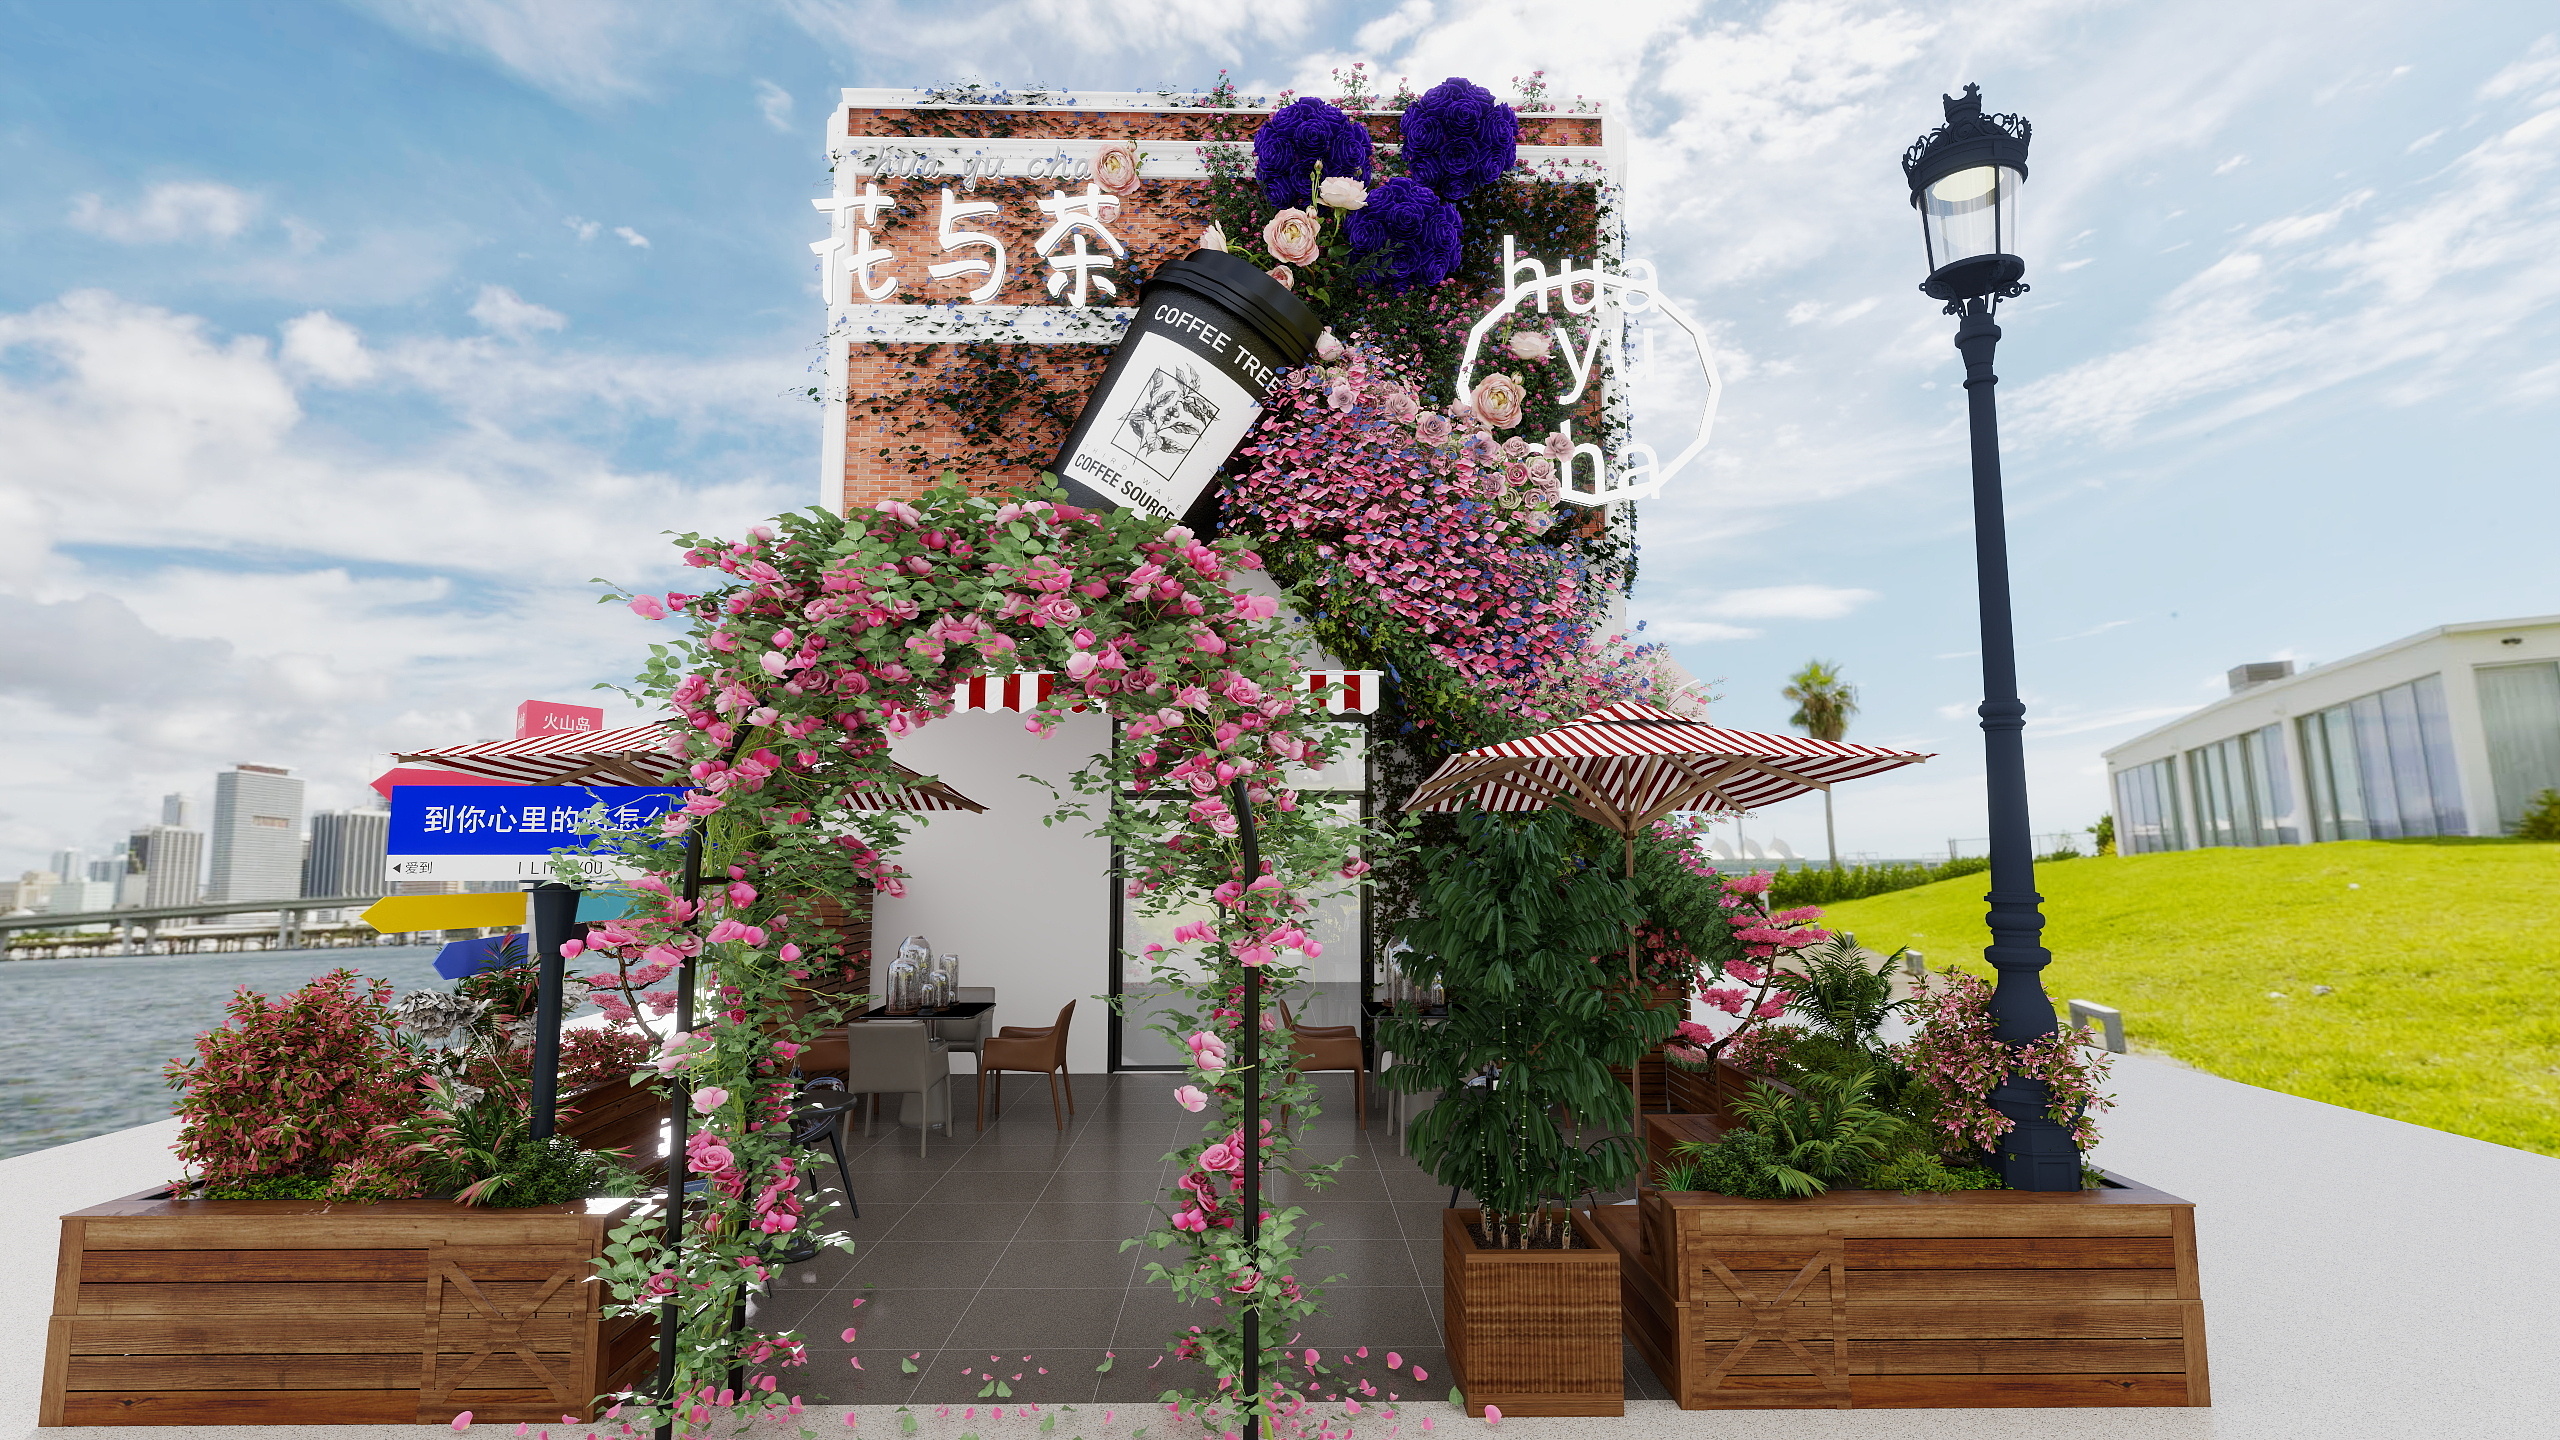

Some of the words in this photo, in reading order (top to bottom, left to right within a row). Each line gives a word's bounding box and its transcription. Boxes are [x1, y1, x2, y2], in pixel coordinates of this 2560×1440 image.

[872, 145, 941, 180] hua
[963, 155, 1005, 192] yu
[1027, 146, 1092, 180] cha
[808, 183, 1126, 311] 花与茶
[1503, 235, 1659, 313] hua
[1154, 304, 1232, 354] COFFEE
[1233, 344, 1282, 397] TREE
[1555, 328, 1654, 405] yu
[1074, 453, 1122, 489] COFFEE
[1084, 443, 1128, 472] THIRD
[1142, 477, 1182, 512] WAVE
[1528, 419, 1661, 500] ha
[542, 712, 591, 732] 火山岛
[405, 861, 433, 875] 爱到
[518, 861, 522, 875] I
